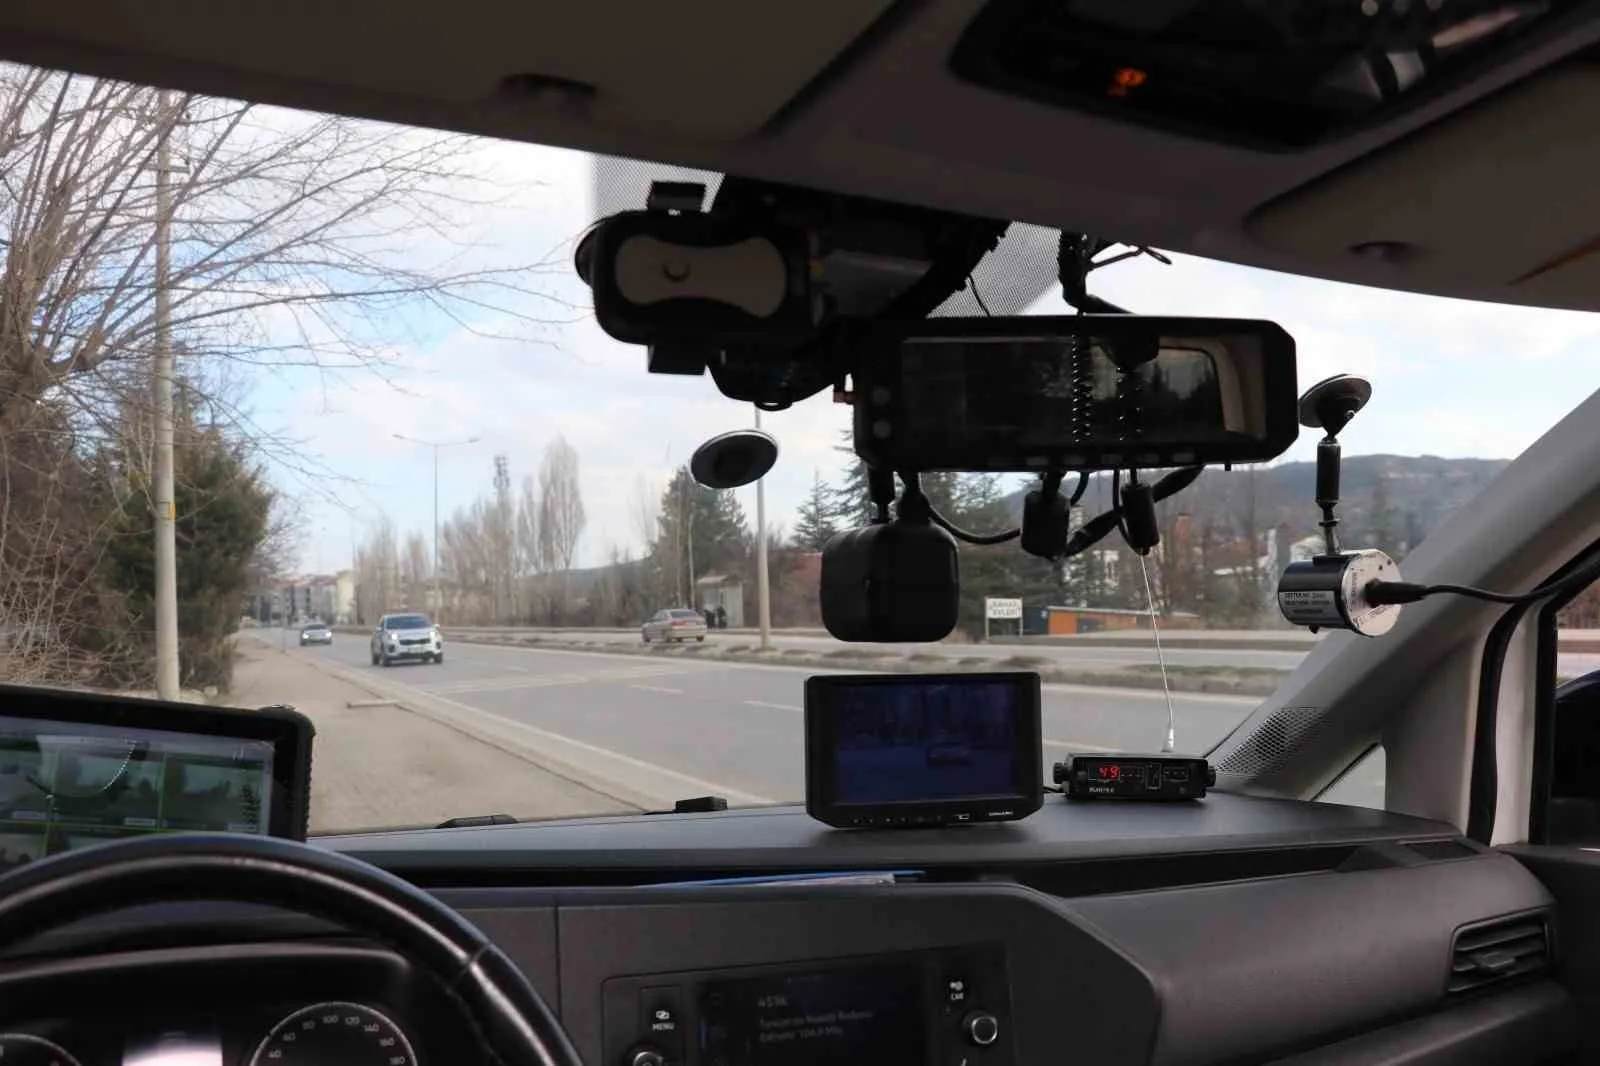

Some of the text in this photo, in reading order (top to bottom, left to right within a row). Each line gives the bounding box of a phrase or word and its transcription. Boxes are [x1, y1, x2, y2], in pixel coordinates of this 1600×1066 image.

[323, 1015, 339, 1024] 100
[345, 1016, 360, 1026] 120
[363, 1023, 380, 1033] 140
[652, 1022, 675, 1031] MENU
[269, 1049, 282, 1058] 40
